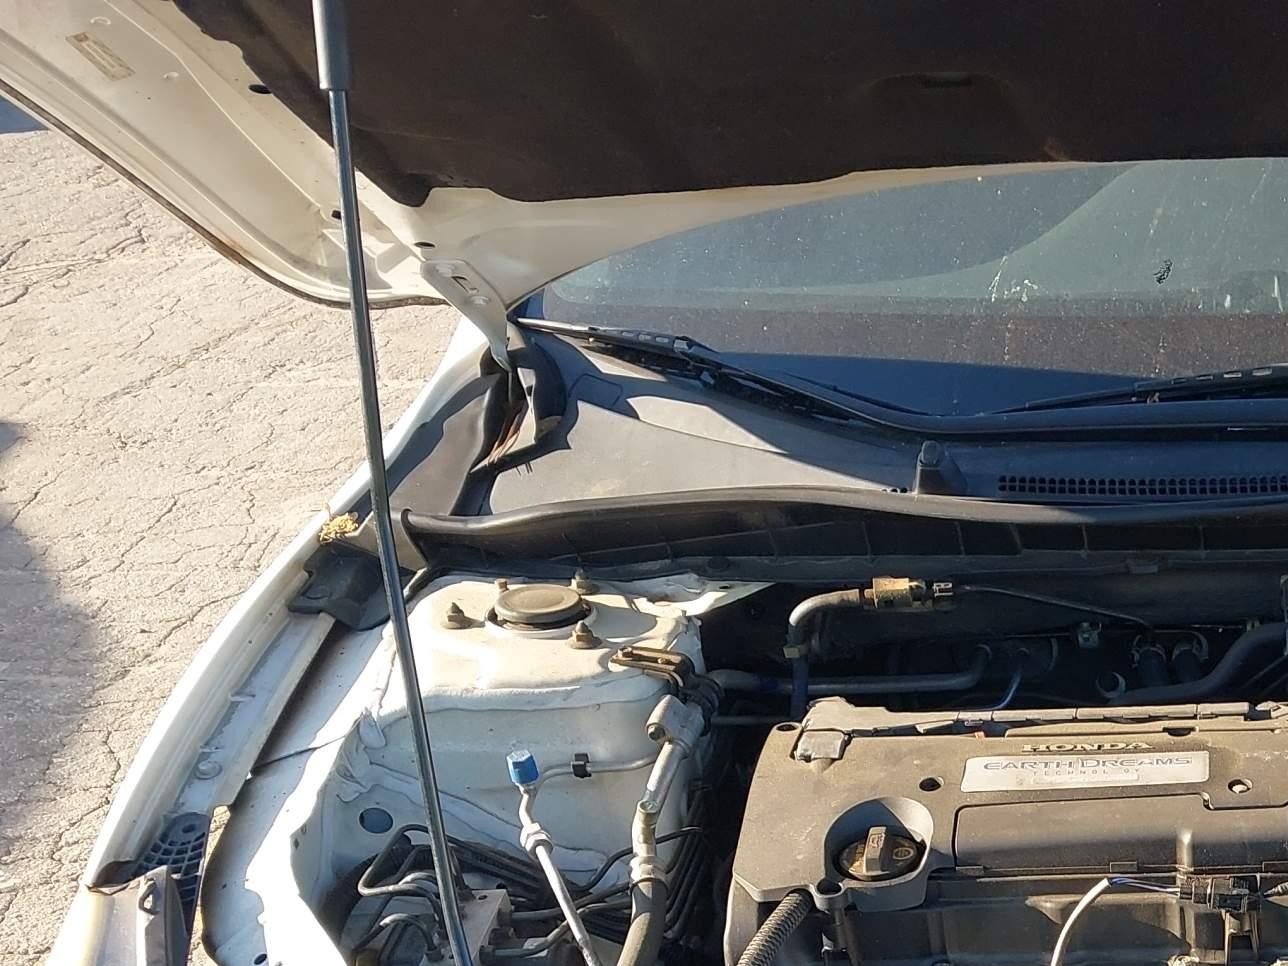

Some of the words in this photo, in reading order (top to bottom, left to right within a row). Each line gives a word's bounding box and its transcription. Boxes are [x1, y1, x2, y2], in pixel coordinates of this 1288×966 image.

[1022, 742, 1153, 753] HONDA
[984, 760, 1073, 770] EARTH
[1081, 757, 1193, 768] DREAMS
[1032, 768, 1139, 777] TECHNOLGY
